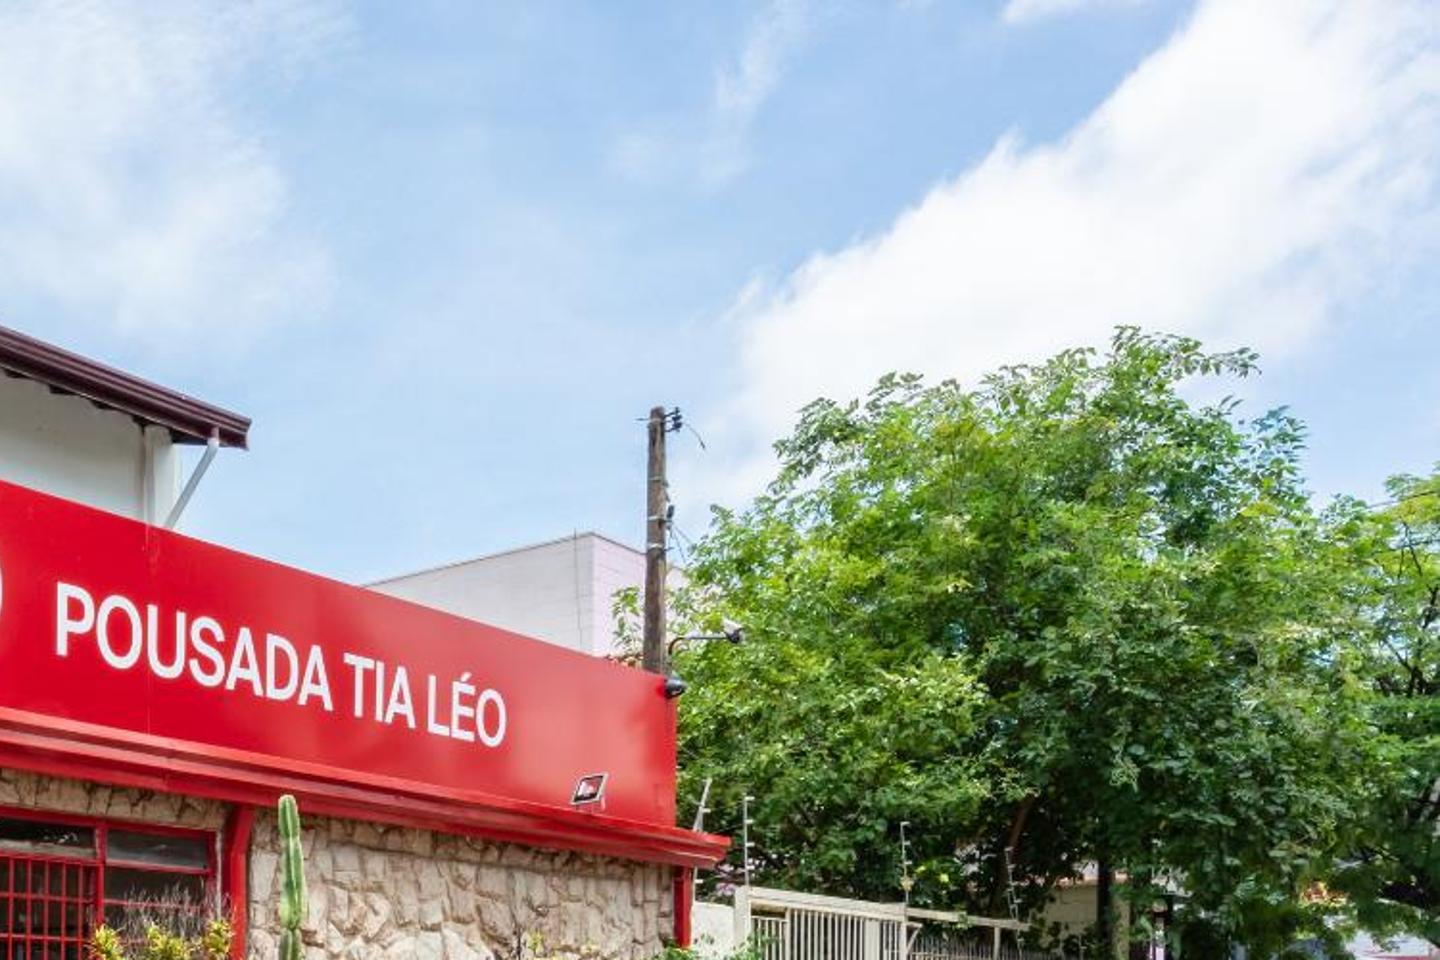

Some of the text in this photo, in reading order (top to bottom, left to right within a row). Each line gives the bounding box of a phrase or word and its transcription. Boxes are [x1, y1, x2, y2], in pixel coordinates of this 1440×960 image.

[55, 581, 333, 712] POUSADA
[344, 652, 416, 729] TIA
[427, 672, 507, 748] LÉO
